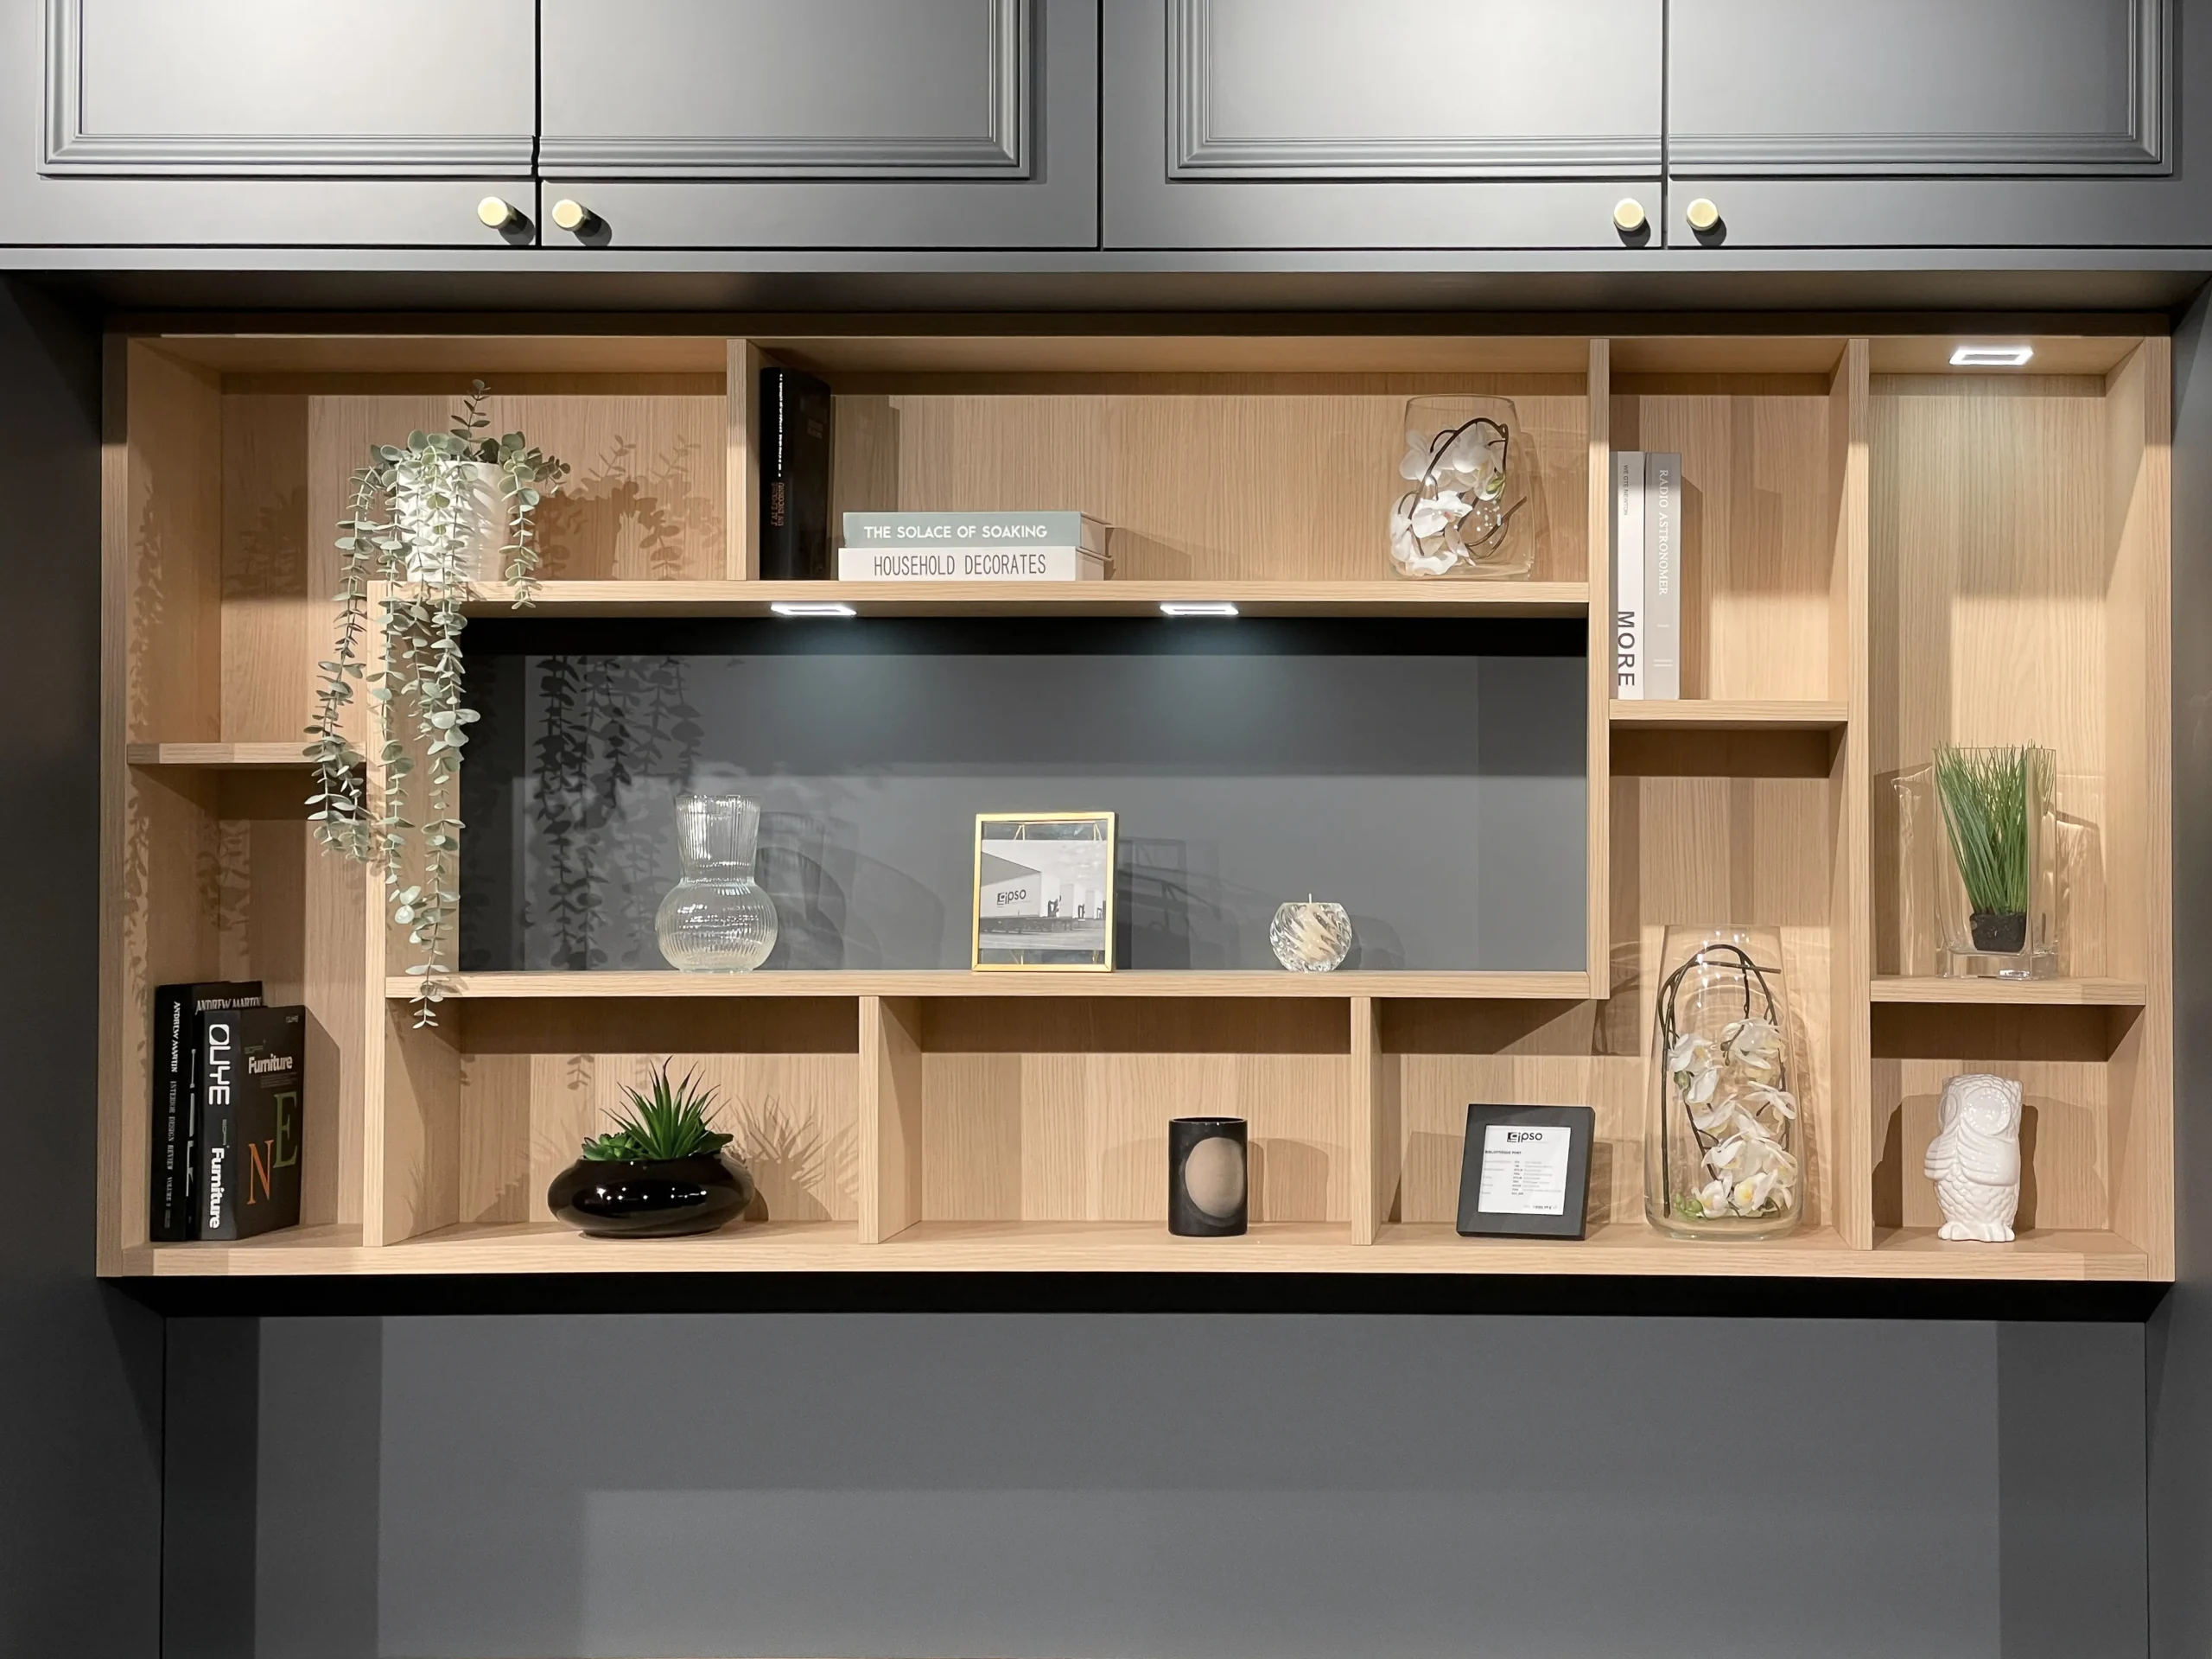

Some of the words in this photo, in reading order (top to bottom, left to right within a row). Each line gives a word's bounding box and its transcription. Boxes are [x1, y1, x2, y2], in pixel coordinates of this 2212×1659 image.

[1624, 464, 1629, 474] WE
[1659, 469, 1669, 508] RADIO
[864, 526, 891, 539] THE
[897, 525, 951, 538] SOLACE
[957, 525, 976, 538] OF
[982, 524, 1048, 538] SOAKING
[874, 555, 956, 576] HOUSEHOLD
[964, 554, 1046, 575] DECORATES
[1658, 512, 1669, 596] ASTRONOMER
[1618, 611, 1635, 687] MORE
[172, 1001, 181, 1039] ANDREW
[248, 1053, 293, 1075] Furniture
[168, 1081, 177, 1114] INTERIOR
[272, 1090, 298, 1168] E
[209, 1147, 225, 1229] Furniture
[246, 1139, 274, 1205] N
